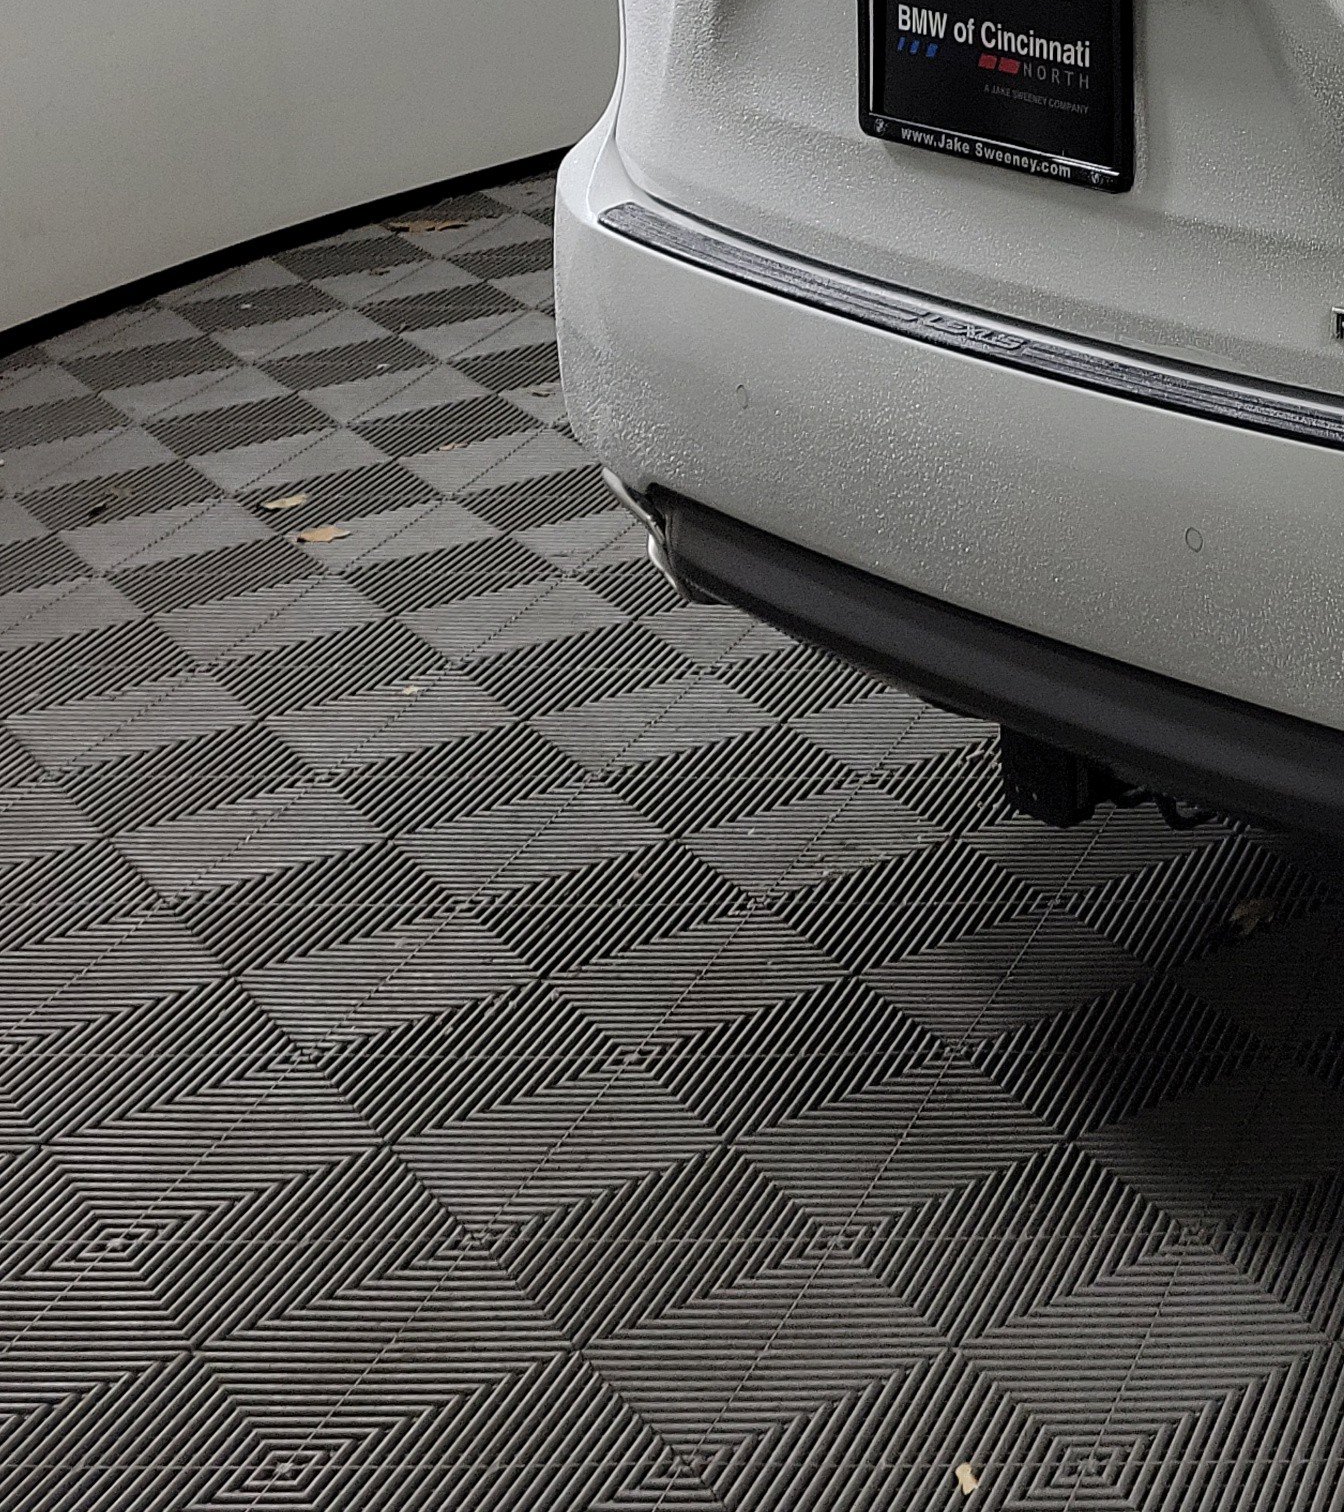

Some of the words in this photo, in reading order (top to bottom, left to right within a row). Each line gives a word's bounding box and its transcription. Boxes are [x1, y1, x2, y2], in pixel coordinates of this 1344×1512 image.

[897, 3, 948, 39] BMW
[953, 18, 975, 45] of
[980, 21, 1090, 68] Cincinnati
[1023, 61, 1090, 90] NORTH
[900, 127, 970, 155] www.Jake
[975, 143, 1071, 179] Sweeney.com
